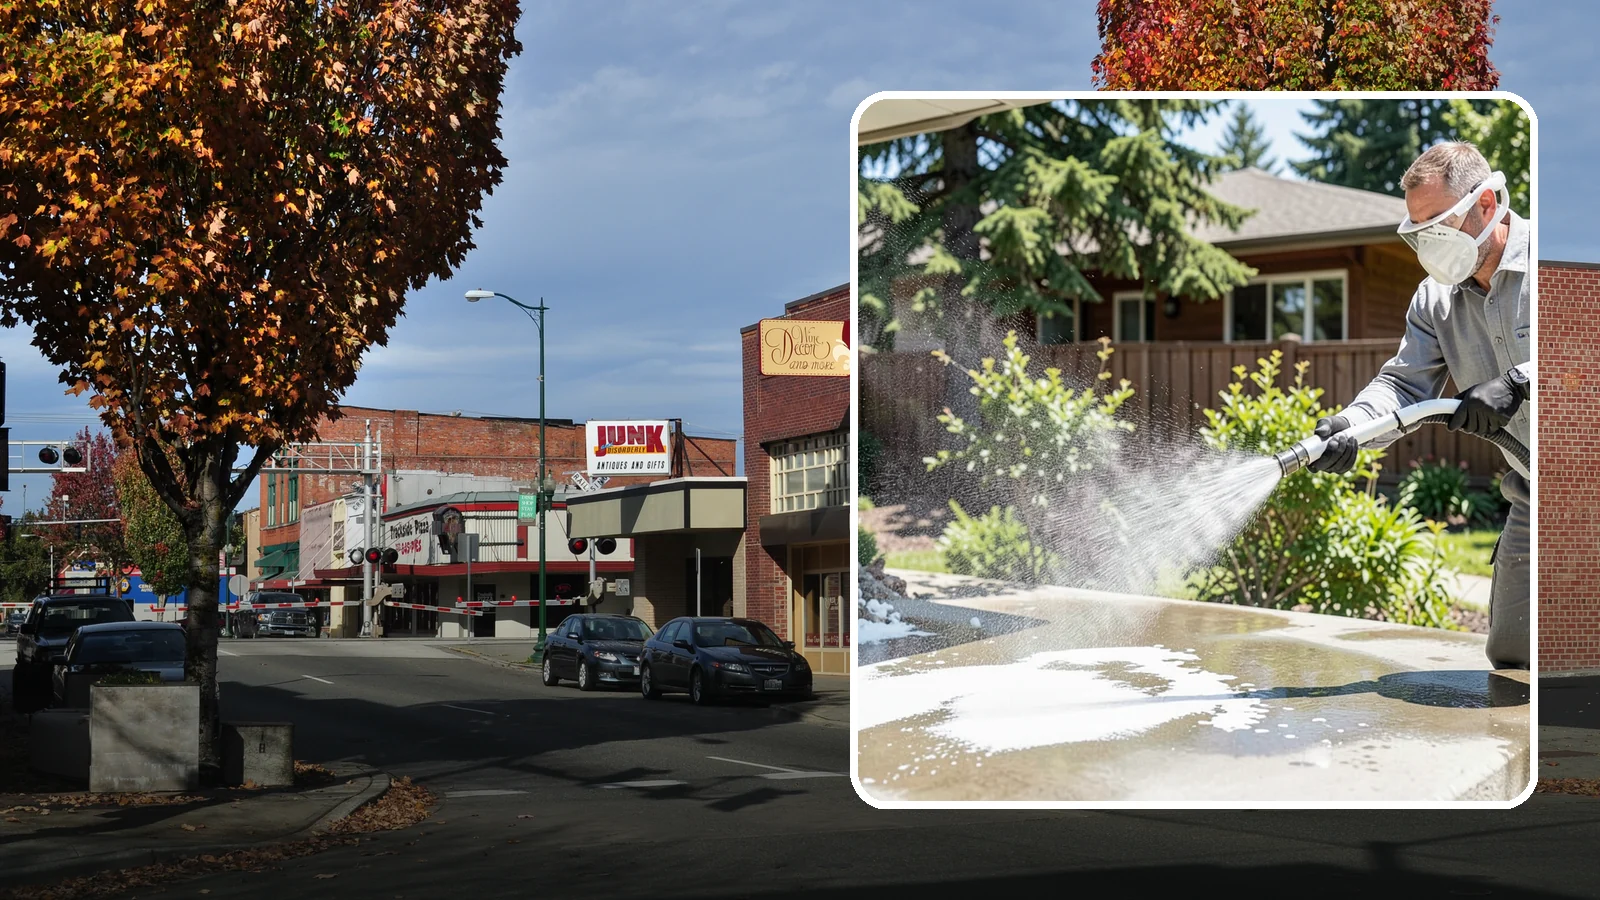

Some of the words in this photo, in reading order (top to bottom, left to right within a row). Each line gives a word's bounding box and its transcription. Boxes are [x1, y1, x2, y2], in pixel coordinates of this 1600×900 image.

[765, 327, 831, 365] Decor
[595, 425, 665, 457] JUNK
[607, 446, 645, 454] DISORDERLY
[597, 461, 628, 470] ANTIQUES
[631, 461, 644, 470] AND
[647, 460, 665, 469] GIFTS
[390, 520, 413, 539] Trackside
[414, 519, 429, 535] Pizza
